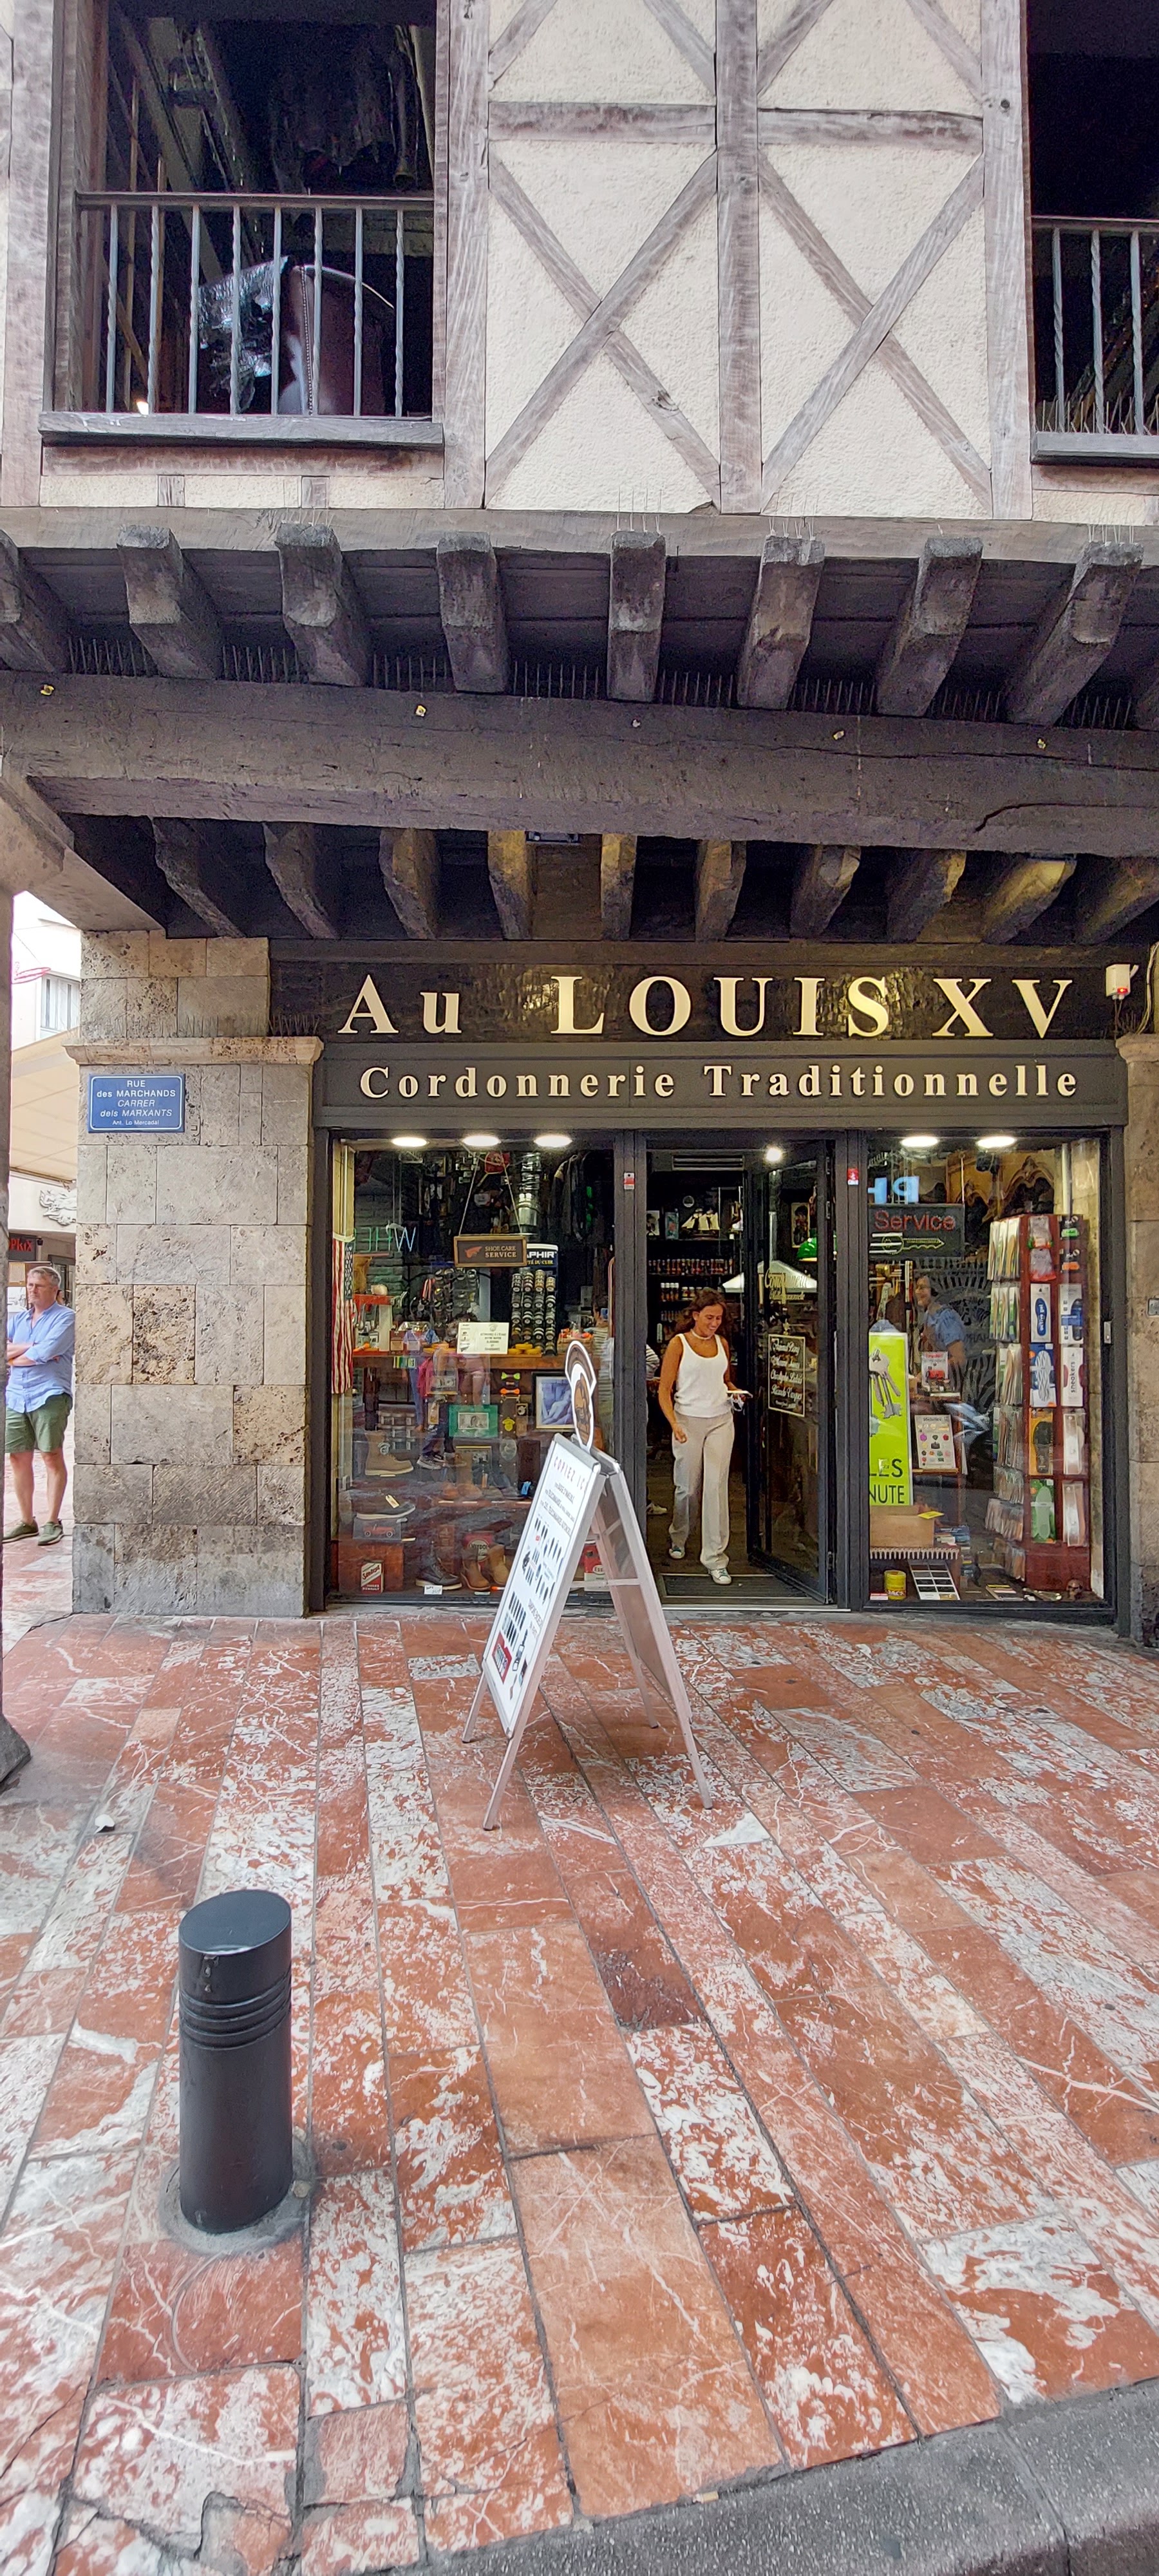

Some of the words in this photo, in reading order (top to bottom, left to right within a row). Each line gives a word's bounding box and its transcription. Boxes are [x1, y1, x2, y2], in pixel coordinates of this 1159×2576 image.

[338, 974, 462, 1034] Au
[551, 976, 889, 1036] LOUIS
[932, 978, 1073, 1038] XV
[360, 1066, 675, 1098] Cordonnerie
[703, 1065, 1077, 1097] Traditionnelle
[118, 1099, 155, 1108] CARRER
[874, 1210, 956, 1231] Service
